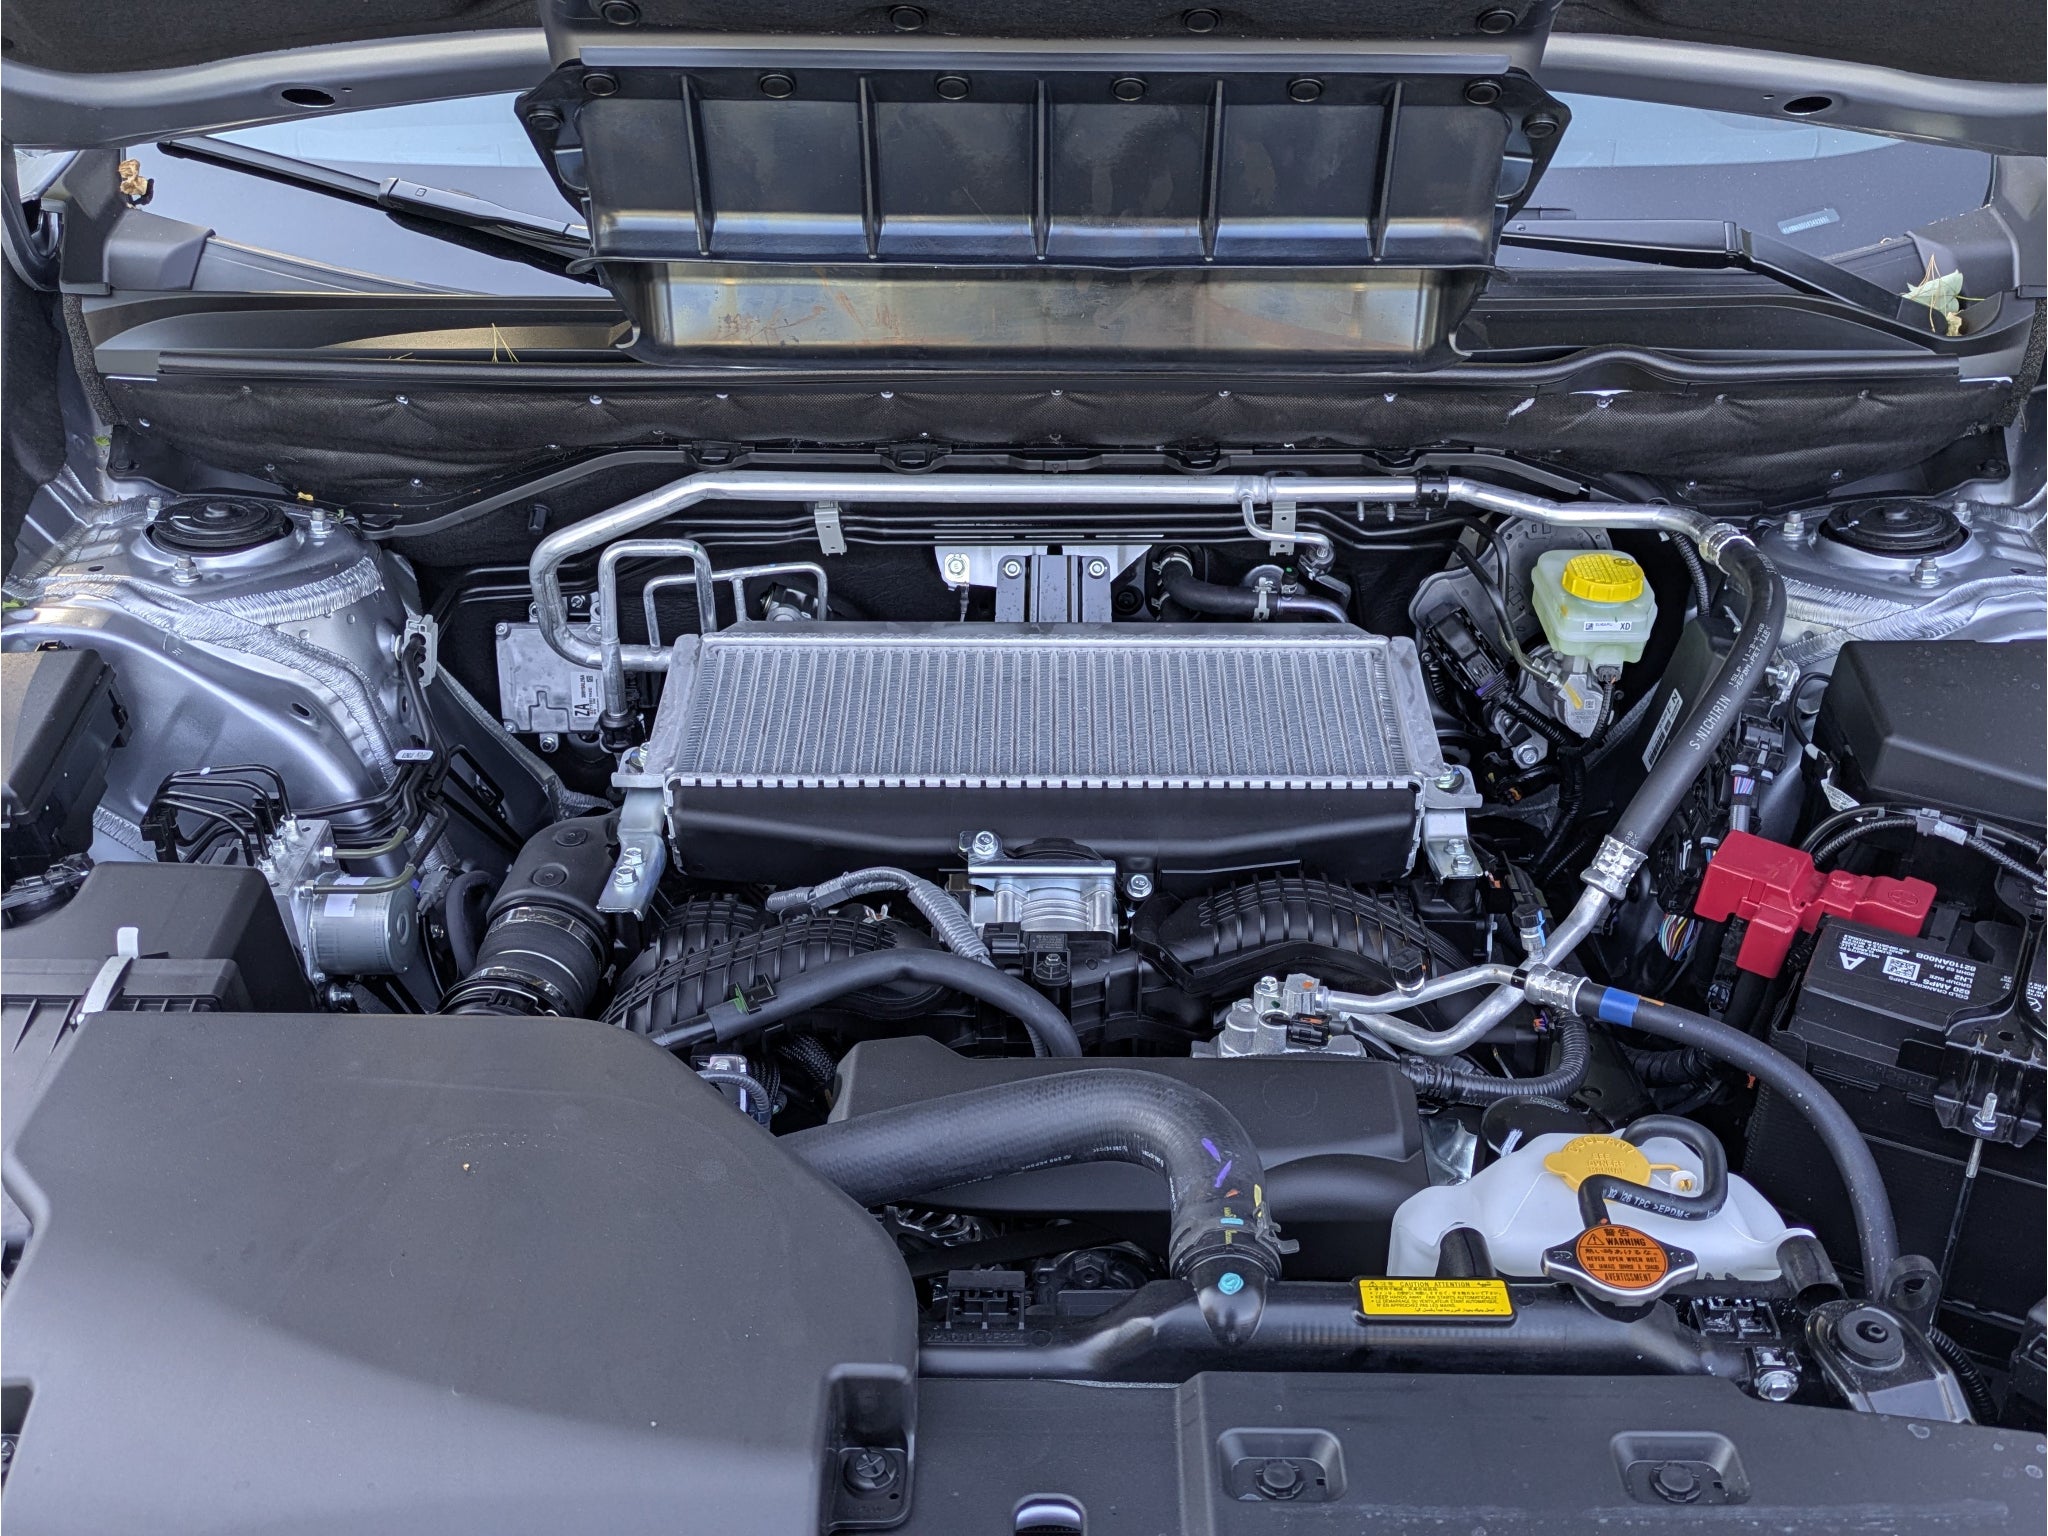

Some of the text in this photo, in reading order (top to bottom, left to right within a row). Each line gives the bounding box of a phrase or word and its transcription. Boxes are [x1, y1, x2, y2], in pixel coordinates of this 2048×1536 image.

[1620, 622, 1631, 631] XD
[1671, 692, 1678, 704] N
[574, 703, 590, 716] ZA
[1839, 951, 1866, 970] A
[1929, 974, 1972, 989] GROUP SIZE
[1954, 974, 1974, 984] LN2
[1888, 975, 1969, 1000] COLD CRANKING AMPS
[1922, 978, 1970, 995] 620 AMPS
[1567, 1136, 1638, 1154] COOLANT
[1634, 1196, 1650, 1209] TPC
[1652, 1203, 1691, 1219] >EPDM<
[1604, 1228, 1630, 1237] 警告
[1606, 1237, 1647, 1247] WARNING
